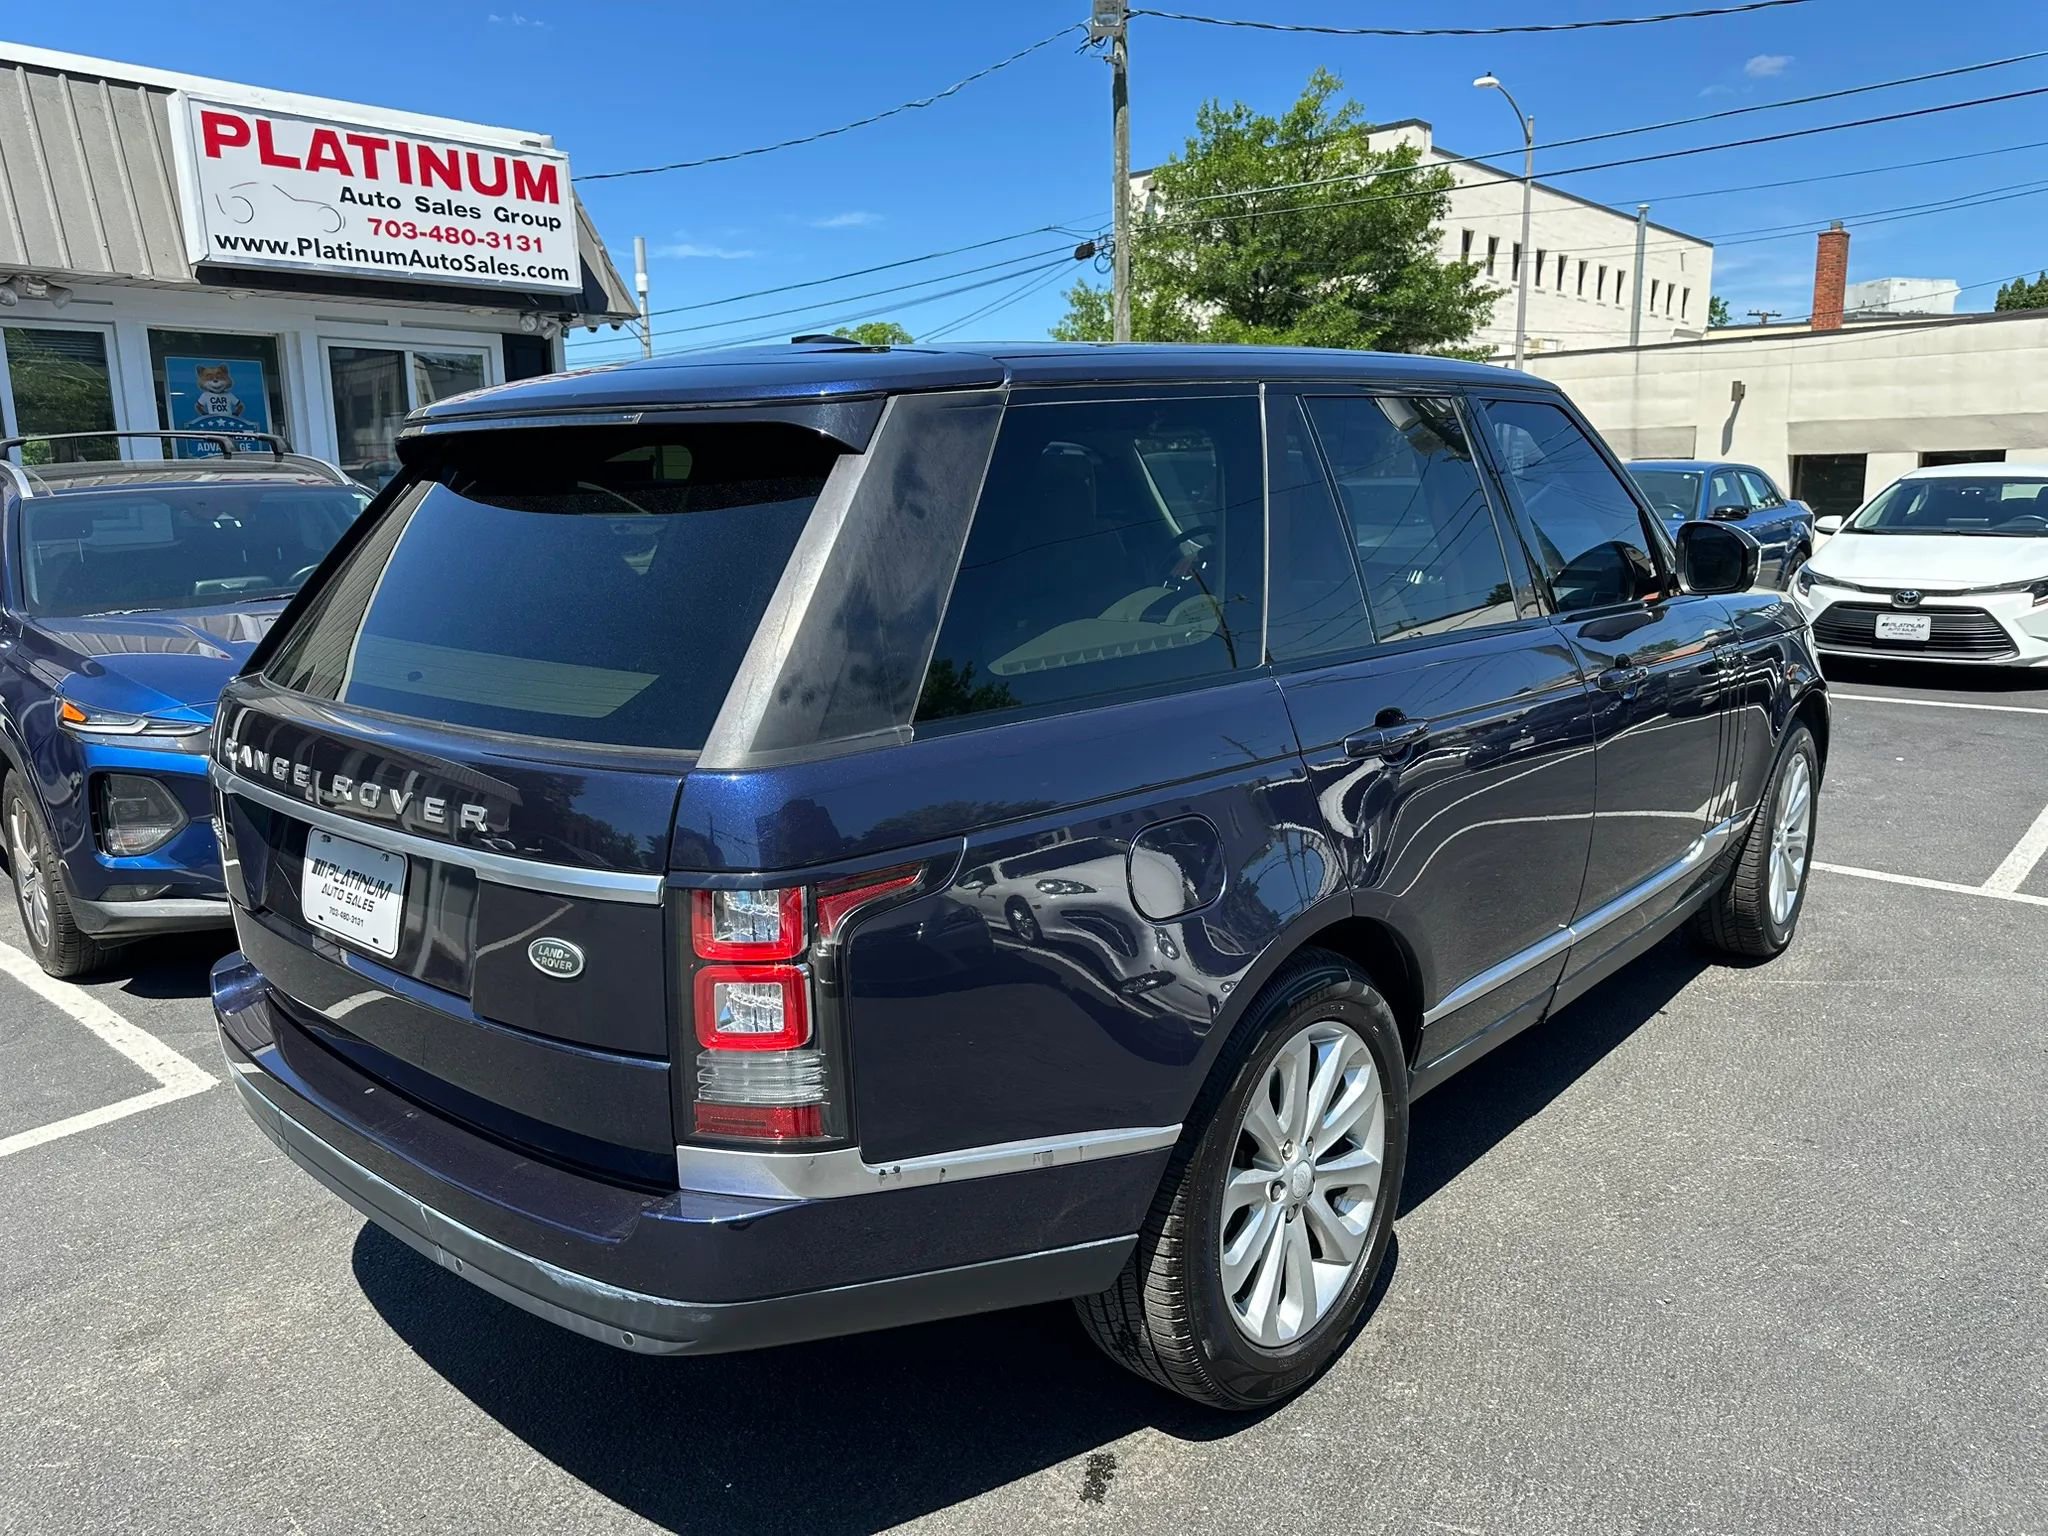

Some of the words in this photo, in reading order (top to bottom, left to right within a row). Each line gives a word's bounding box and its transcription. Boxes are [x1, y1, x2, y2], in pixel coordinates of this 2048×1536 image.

[201, 110, 560, 205] PLATINUM
[340, 186, 401, 210] Auto
[415, 196, 481, 220] Sales
[493, 206, 562, 232] Group
[367, 217, 543, 253] 703-480-3131
[215, 233, 569, 281] www.PlatinumAutoSales.com
[210, 396, 227, 404] CAR
[212, 404, 228, 412] FOX
[197, 442, 251, 452] ADVAGE
[225, 738, 311, 787] RANGE
[332, 774, 488, 832] ROVER
[321, 883, 345, 901] AUTO
[345, 892, 375, 912] SALES
[325, 862, 393, 901] PLATINUM
[538, 945, 564, 959] LAND
[541, 956, 572, 970] ROVER
